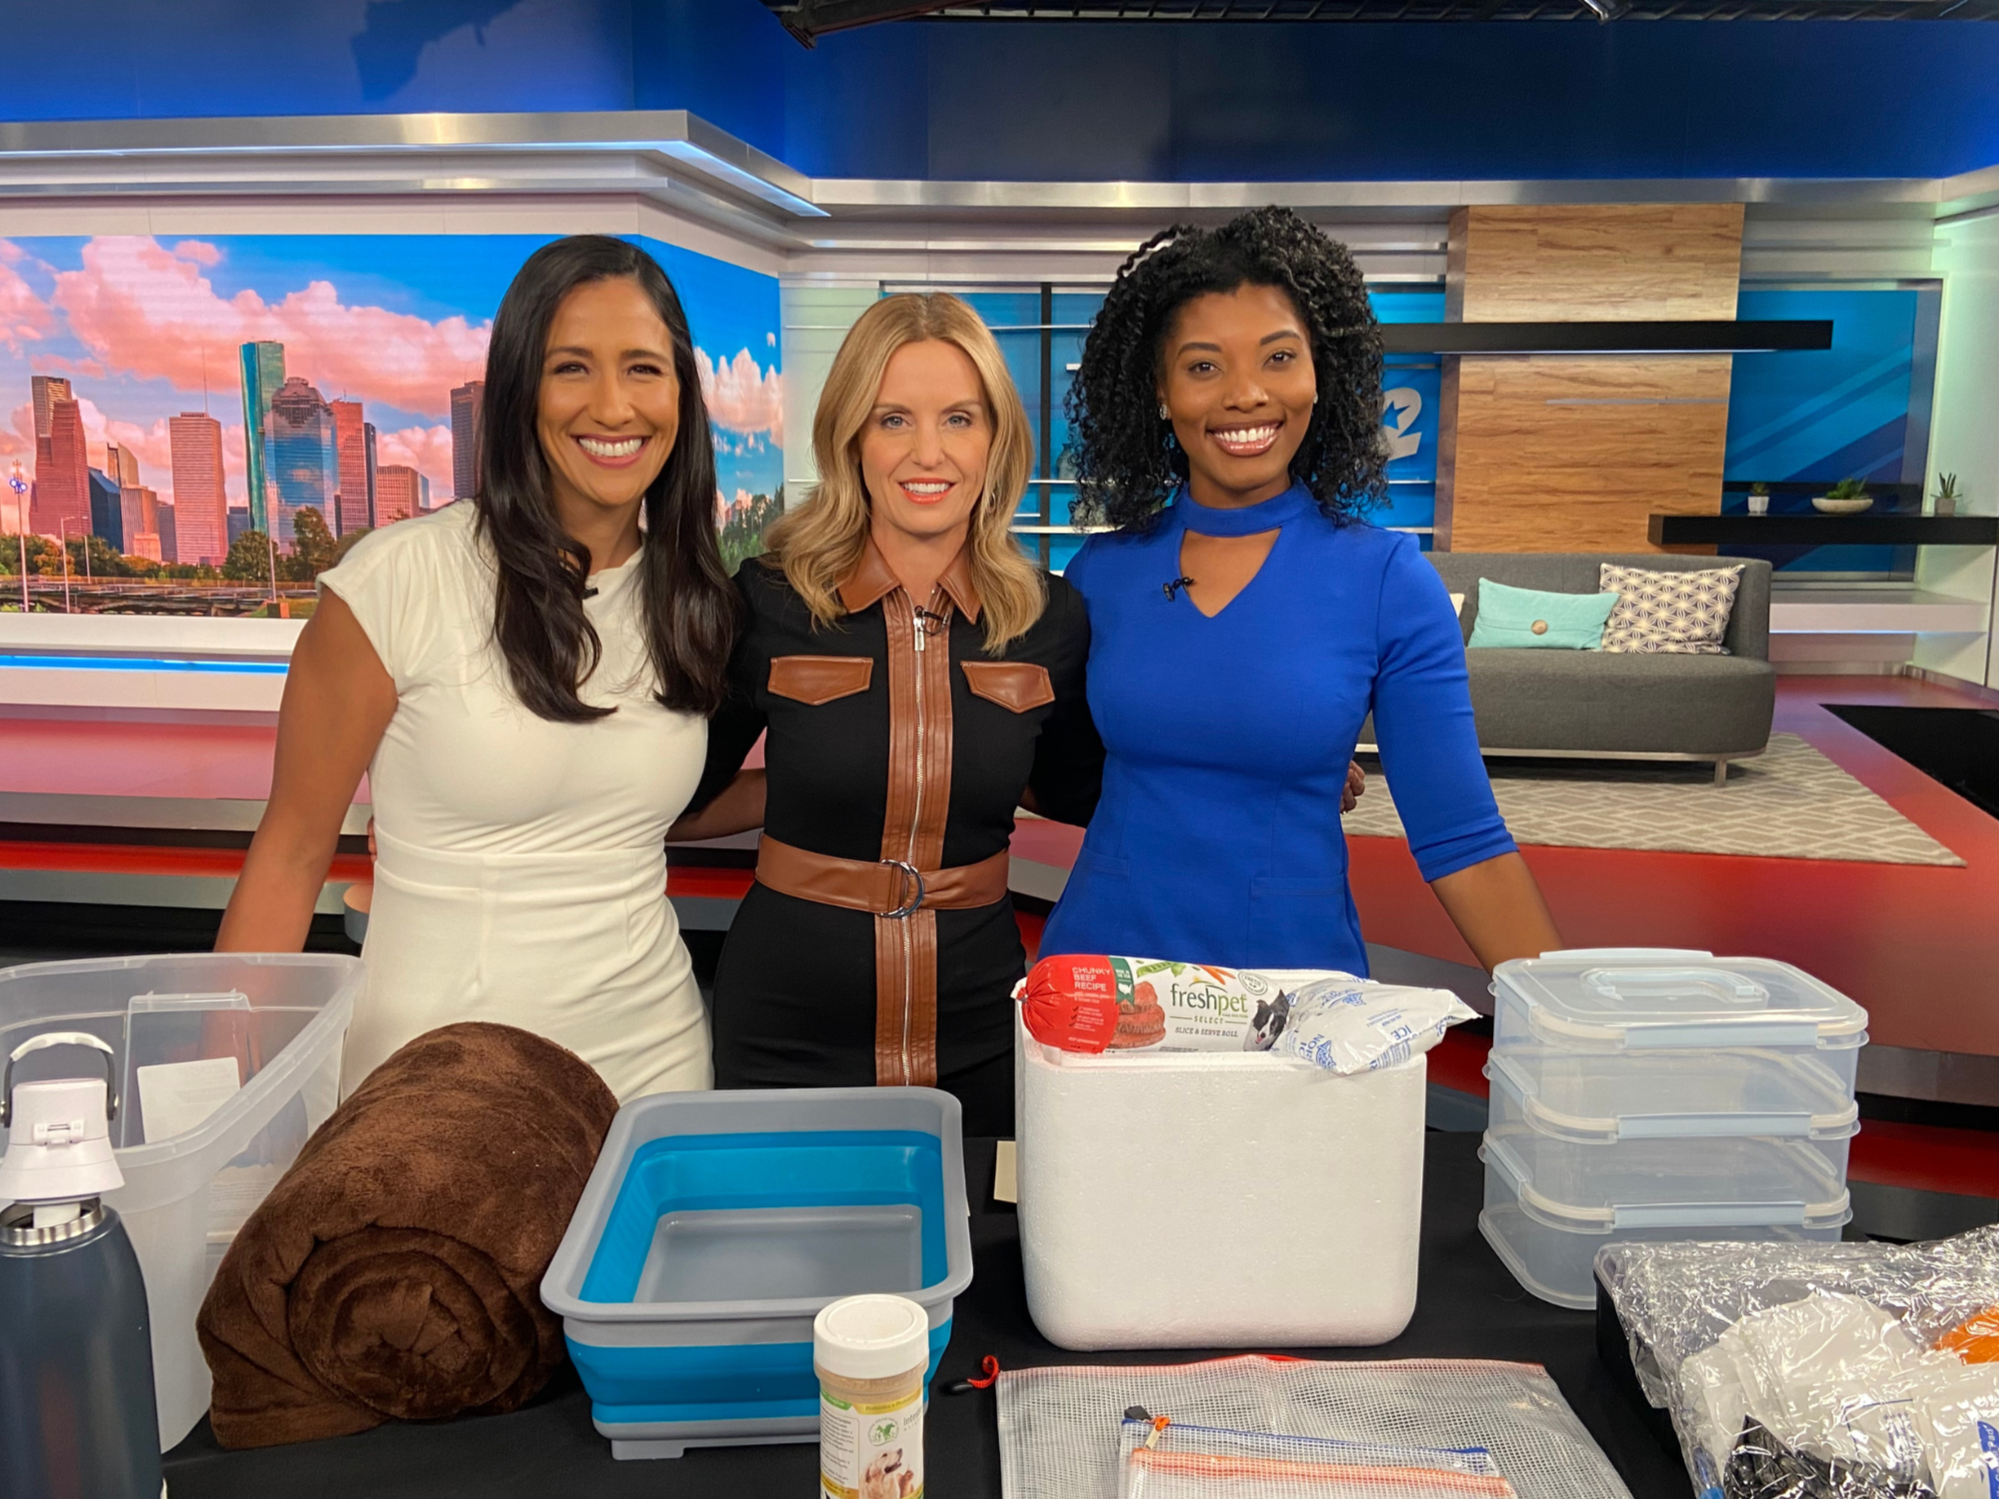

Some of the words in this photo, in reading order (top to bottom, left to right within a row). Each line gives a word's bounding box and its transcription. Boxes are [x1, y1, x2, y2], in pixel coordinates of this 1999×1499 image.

[1072, 966, 1111, 976] CHUNKY
[1073, 974, 1097, 982] BEEF
[1074, 981, 1107, 992] RECIPE
[1170, 983, 1248, 1016] freshpet
[1194, 1015, 1223, 1025] SELECT
[1175, 1026, 1194, 1035] SLICE
[1200, 1029, 1221, 1037] SERVE
[1221, 1030, 1238, 1038] ROLL
[1391, 1024, 1412, 1041] ICE
